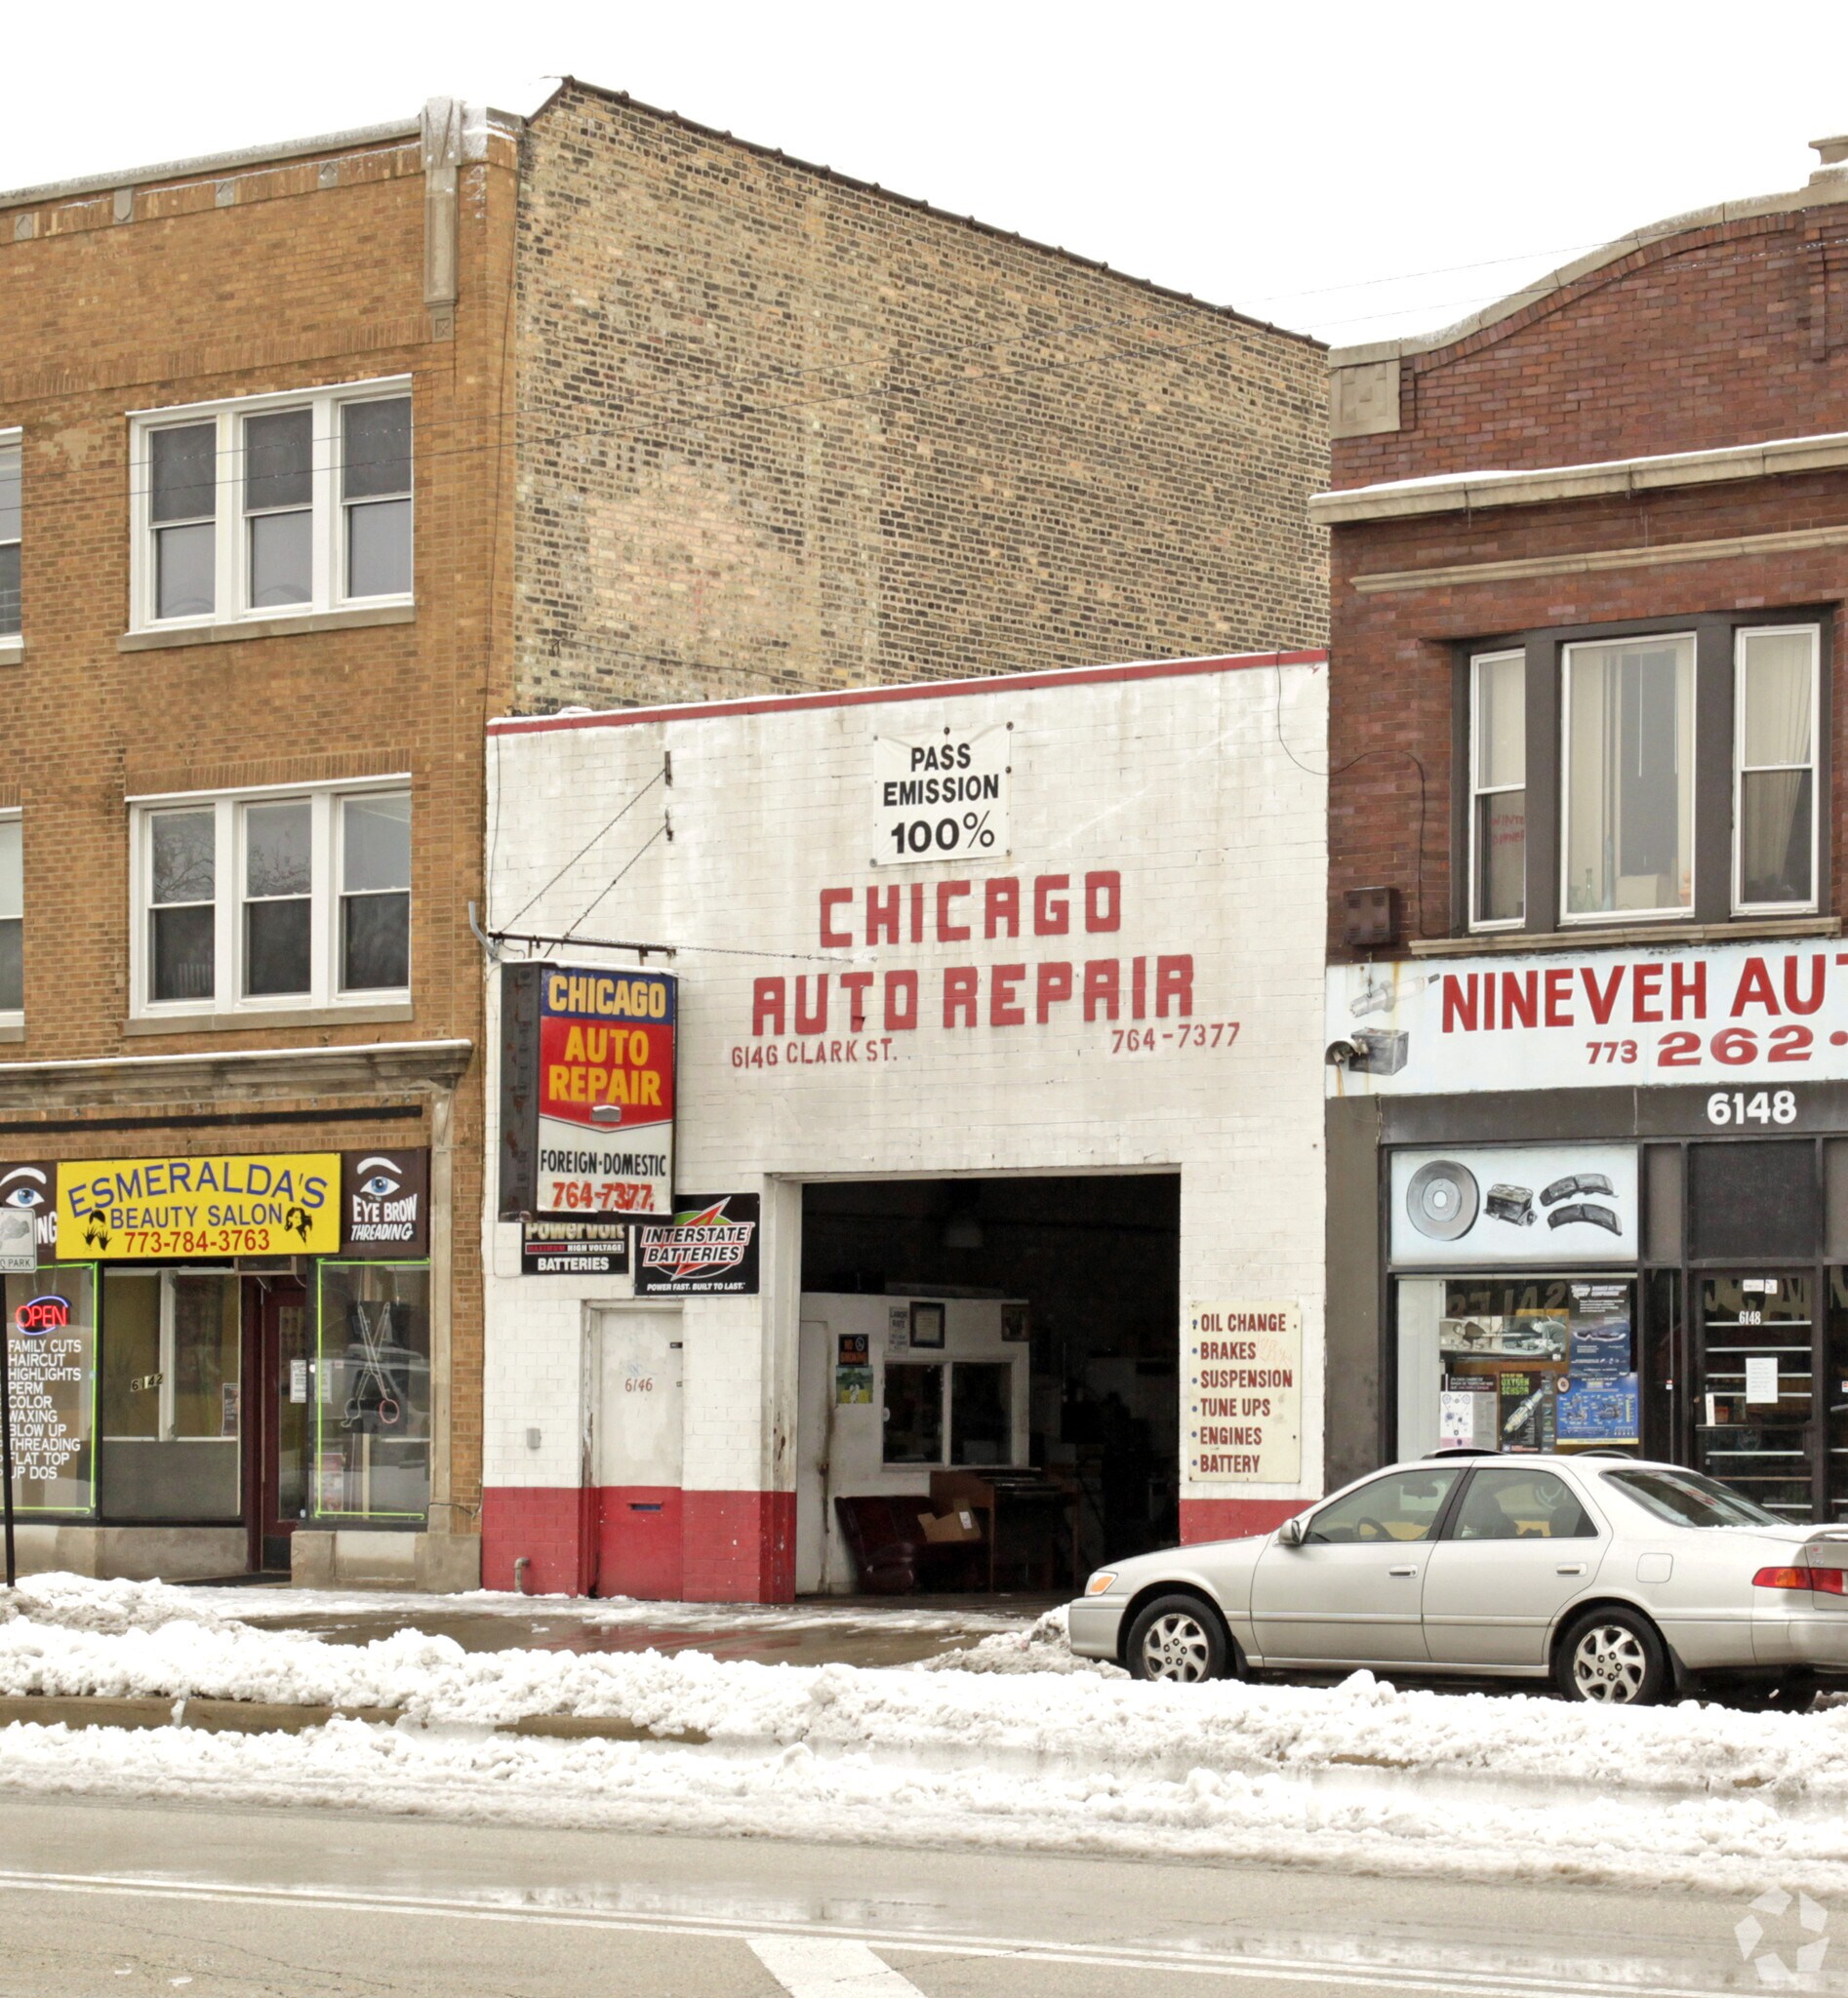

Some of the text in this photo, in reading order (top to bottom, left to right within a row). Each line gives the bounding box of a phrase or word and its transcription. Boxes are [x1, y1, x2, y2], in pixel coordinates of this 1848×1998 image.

[911, 743, 971, 772] PASS
[883, 774, 999, 807] EMISSION
[891, 810, 995, 854] 100%
[820, 870, 1121, 948] CHICAGO
[548, 976, 666, 1019] CHICAGO
[752, 954, 1194, 1036] AUTO REPAIR
[1441, 953, 1848, 1034] NINEVEH AU
[564, 1026, 649, 1066] AUTO
[1111, 1021, 1241, 1055] 764-7377
[732, 1037, 898, 1069] 6146 CLARK ST.
[1586, 1039, 1638, 1065] 773
[548, 1064, 663, 1106] REPAIR
[1707, 1090, 1797, 1126] 6148
[67, 1161, 328, 1219] ESMERALDA'S
[110, 1203, 282, 1230] BEAUTY SALON
[352, 1193, 418, 1222] EYE BROW
[124, 1228, 270, 1253] 773-784-3763
[350, 1222, 414, 1241] THREADING
[645, 1226, 748, 1244] INTERSTATE
[8, 1258, 31, 1267] PARK
[647, 1246, 740, 1262] BATTERIES
[538, 1257, 610, 1271] BATTERIES
[15, 1304, 67, 1328] OPEN
[1200, 1313, 1287, 1332] OIL CHANGE
[1739, 1310, 1761, 1325] 6148
[8, 1339, 82, 1353] FAMILY CUTS
[1200, 1341, 1256, 1360] BRAKES
[8, 1353, 65, 1367] HAIRCUT
[8, 1367, 82, 1381] HIGHLIGHTS
[132, 1374, 163, 1391] 6142
[1200, 1369, 1293, 1389] SUSPENSION
[8, 1381, 44, 1395] PERM
[624, 1378, 653, 1392] 6146
[8, 1395, 53, 1409] COLOR
[1200, 1398, 1270, 1417] TUNE UPS
[9, 1409, 58, 1423] WAXING
[9, 1423, 67, 1437] BLOW UP
[1200, 1426, 1263, 1445] ENGINES
[9, 1438, 81, 1452] THREADING
[43, 1452, 70, 1465] TOP
[1200, 1454, 1261, 1473] BATTERY
[29, 1465, 58, 1480] DOS
